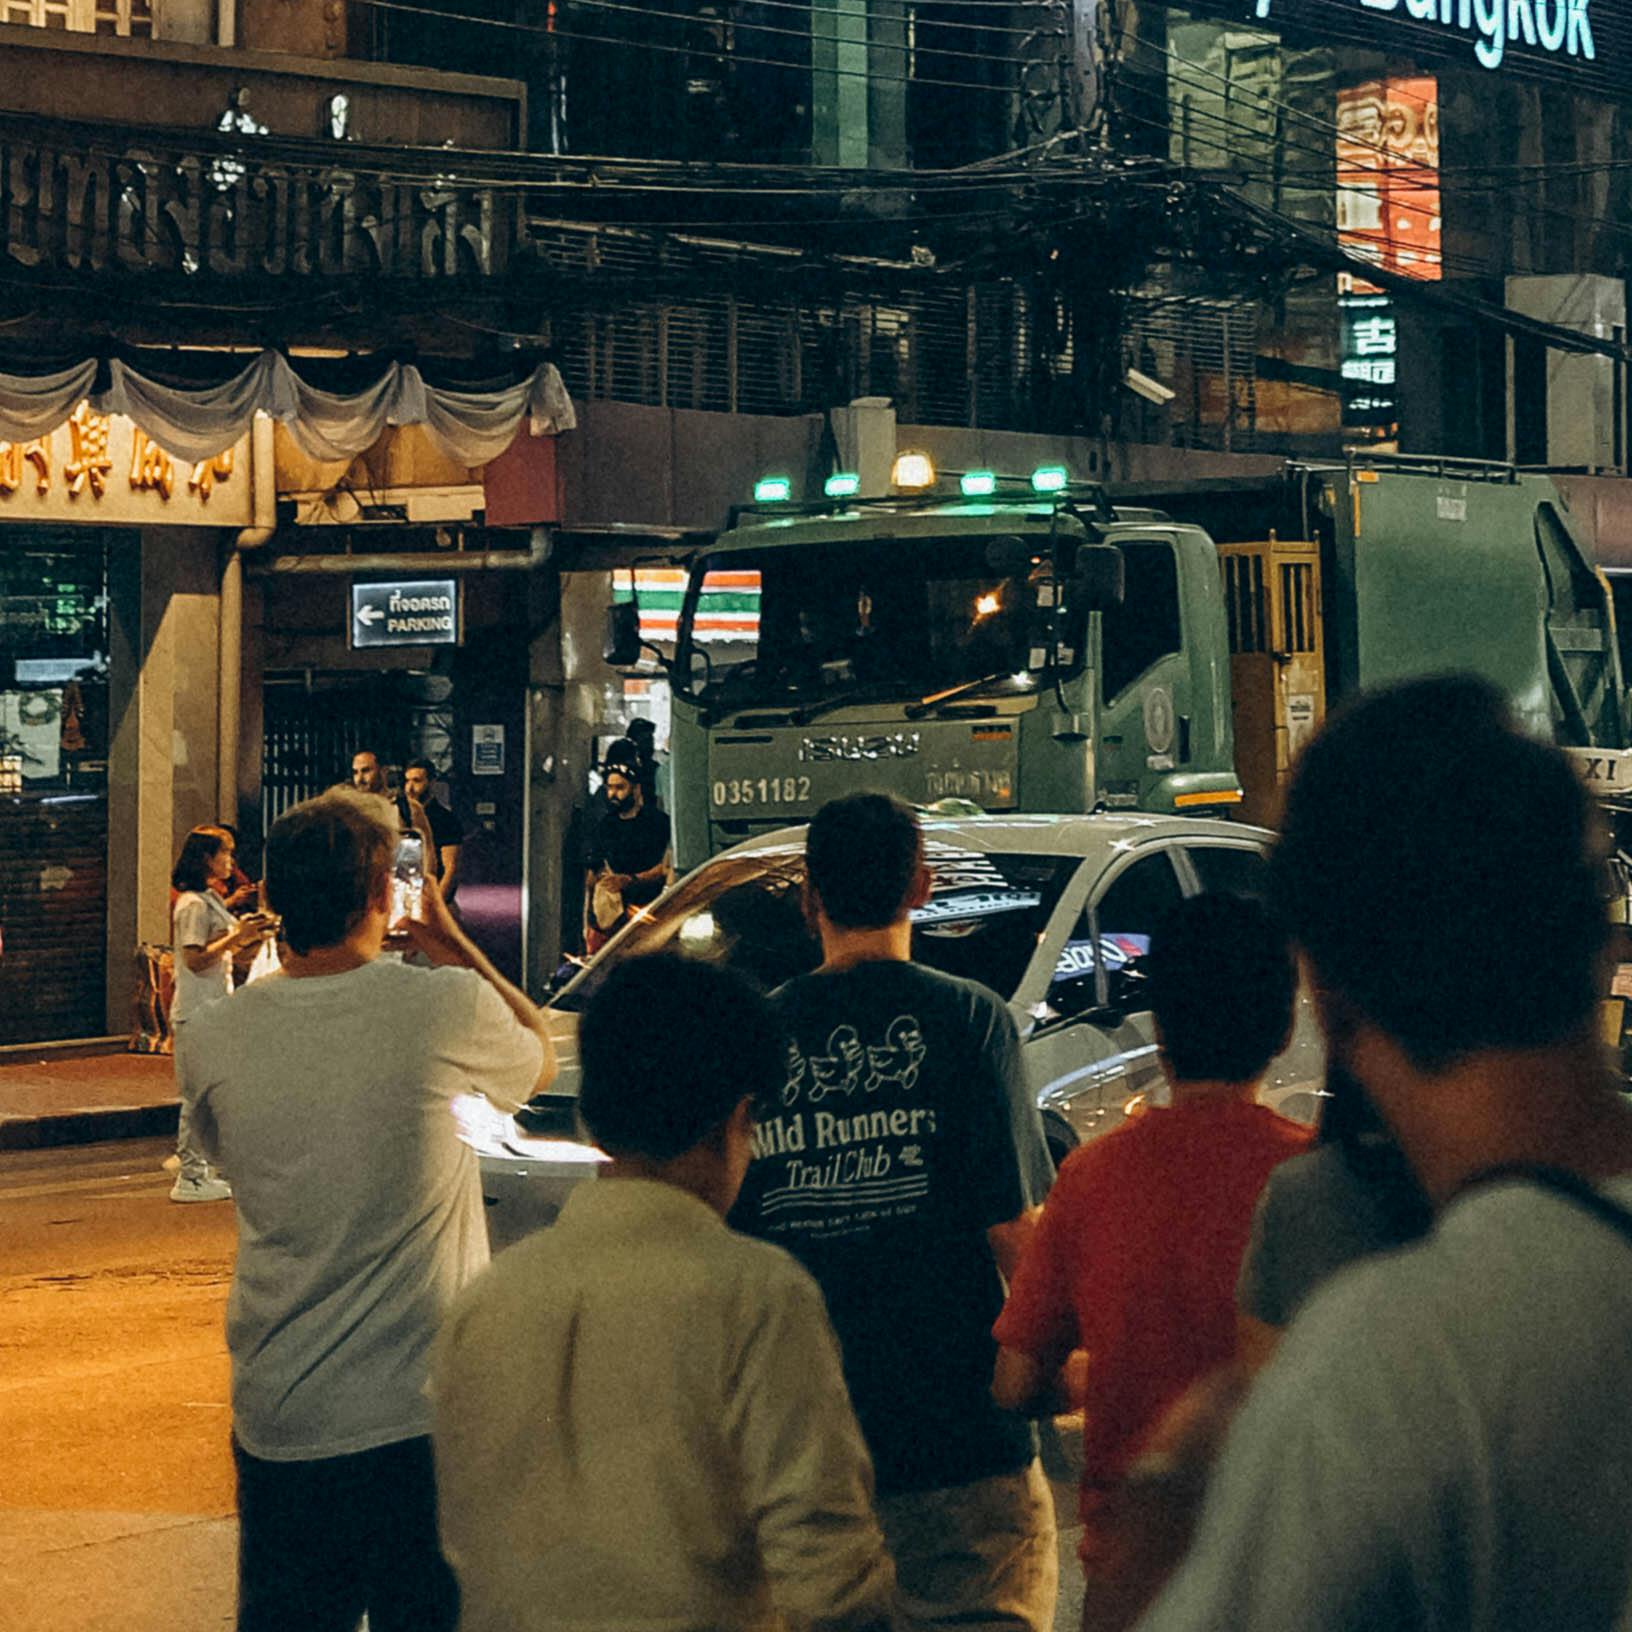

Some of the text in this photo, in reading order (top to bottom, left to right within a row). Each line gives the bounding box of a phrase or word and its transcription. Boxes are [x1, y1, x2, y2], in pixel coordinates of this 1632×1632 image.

[387, 615, 453, 633] PARKING
[1584, 757, 1617, 781] XI
[712, 776, 812, 807] 0351182
[786, 1144, 892, 1191] Trail Club
